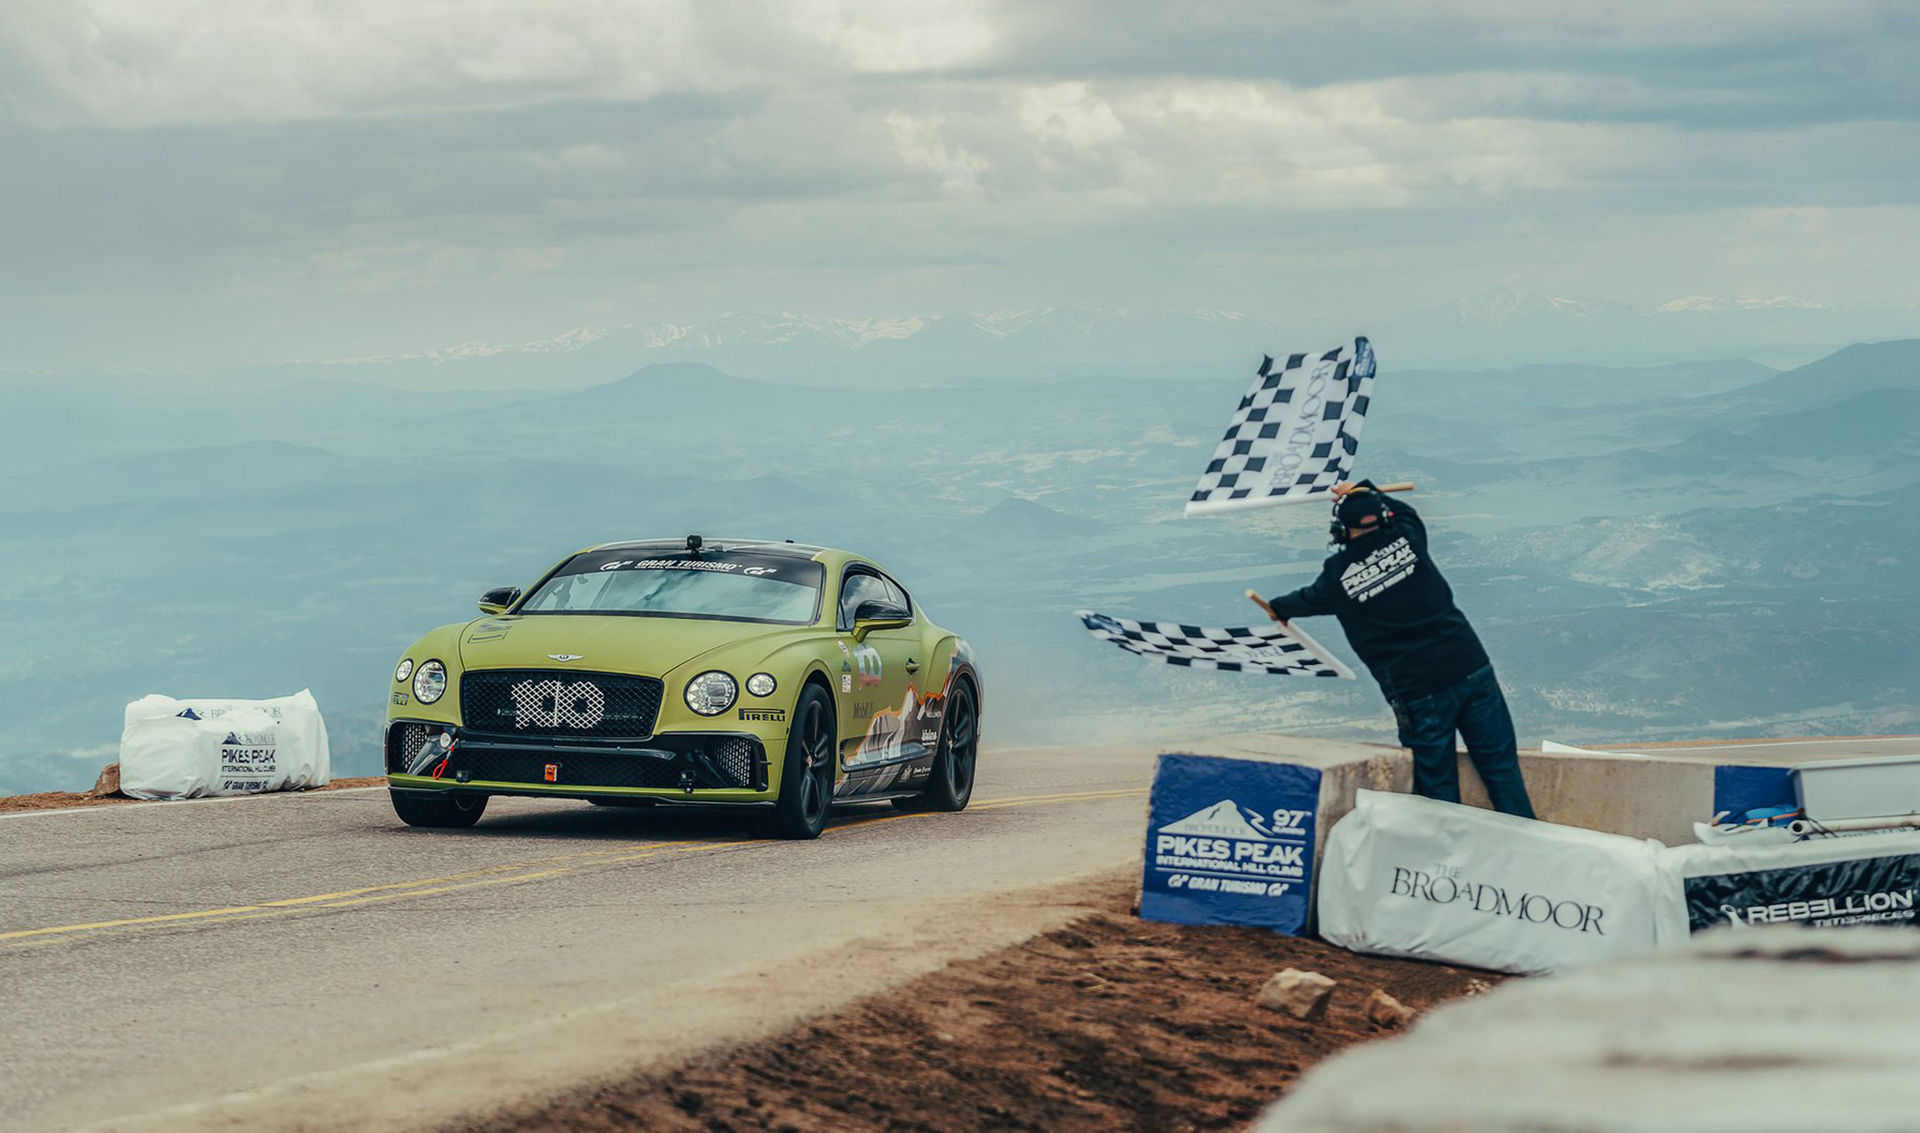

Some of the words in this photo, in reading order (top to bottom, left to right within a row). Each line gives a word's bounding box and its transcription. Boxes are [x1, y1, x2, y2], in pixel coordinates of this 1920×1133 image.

[677, 560, 738, 570] TURISMO
[510, 679, 605, 729] 100
[738, 708, 785, 722] PIRELLI
[221, 749, 250, 764] PIKES
[251, 749, 276, 764] PEAK
[1157, 835, 1230, 859] PIKES
[1234, 842, 1304, 866] PEAK
[1156, 855, 1241, 872] INTERNATIONAL
[1242, 863, 1267, 874] HILL
[1434, 862, 1463, 879] THE
[1188, 877, 1220, 891] GRAN
[1391, 866, 1605, 935] BROADMOOR
[1747, 890, 1914, 925] REBELLION
